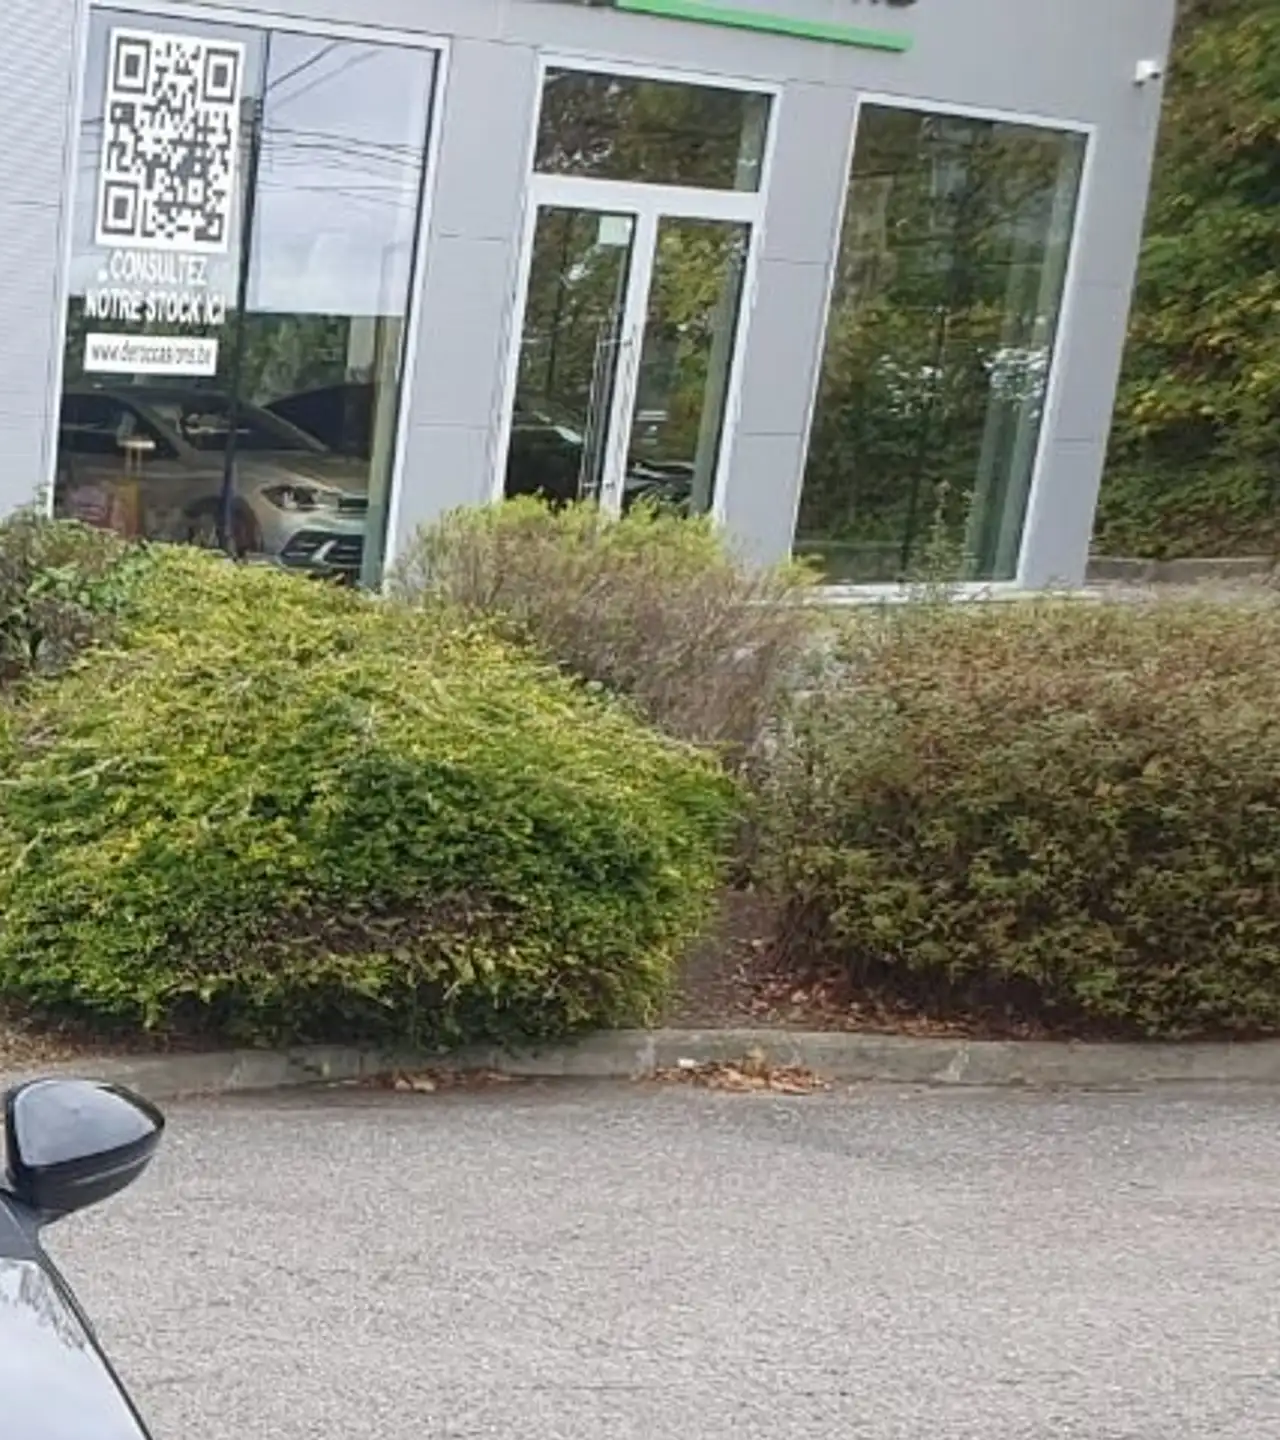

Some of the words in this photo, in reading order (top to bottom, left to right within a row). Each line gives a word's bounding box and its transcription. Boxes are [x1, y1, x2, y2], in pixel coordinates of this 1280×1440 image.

[110, 249, 207, 287] CONSULTEZ
[85, 287, 141, 321] NOTRE
[145, 290, 201, 323] STOCK
[203, 293, 226, 324] ICI
